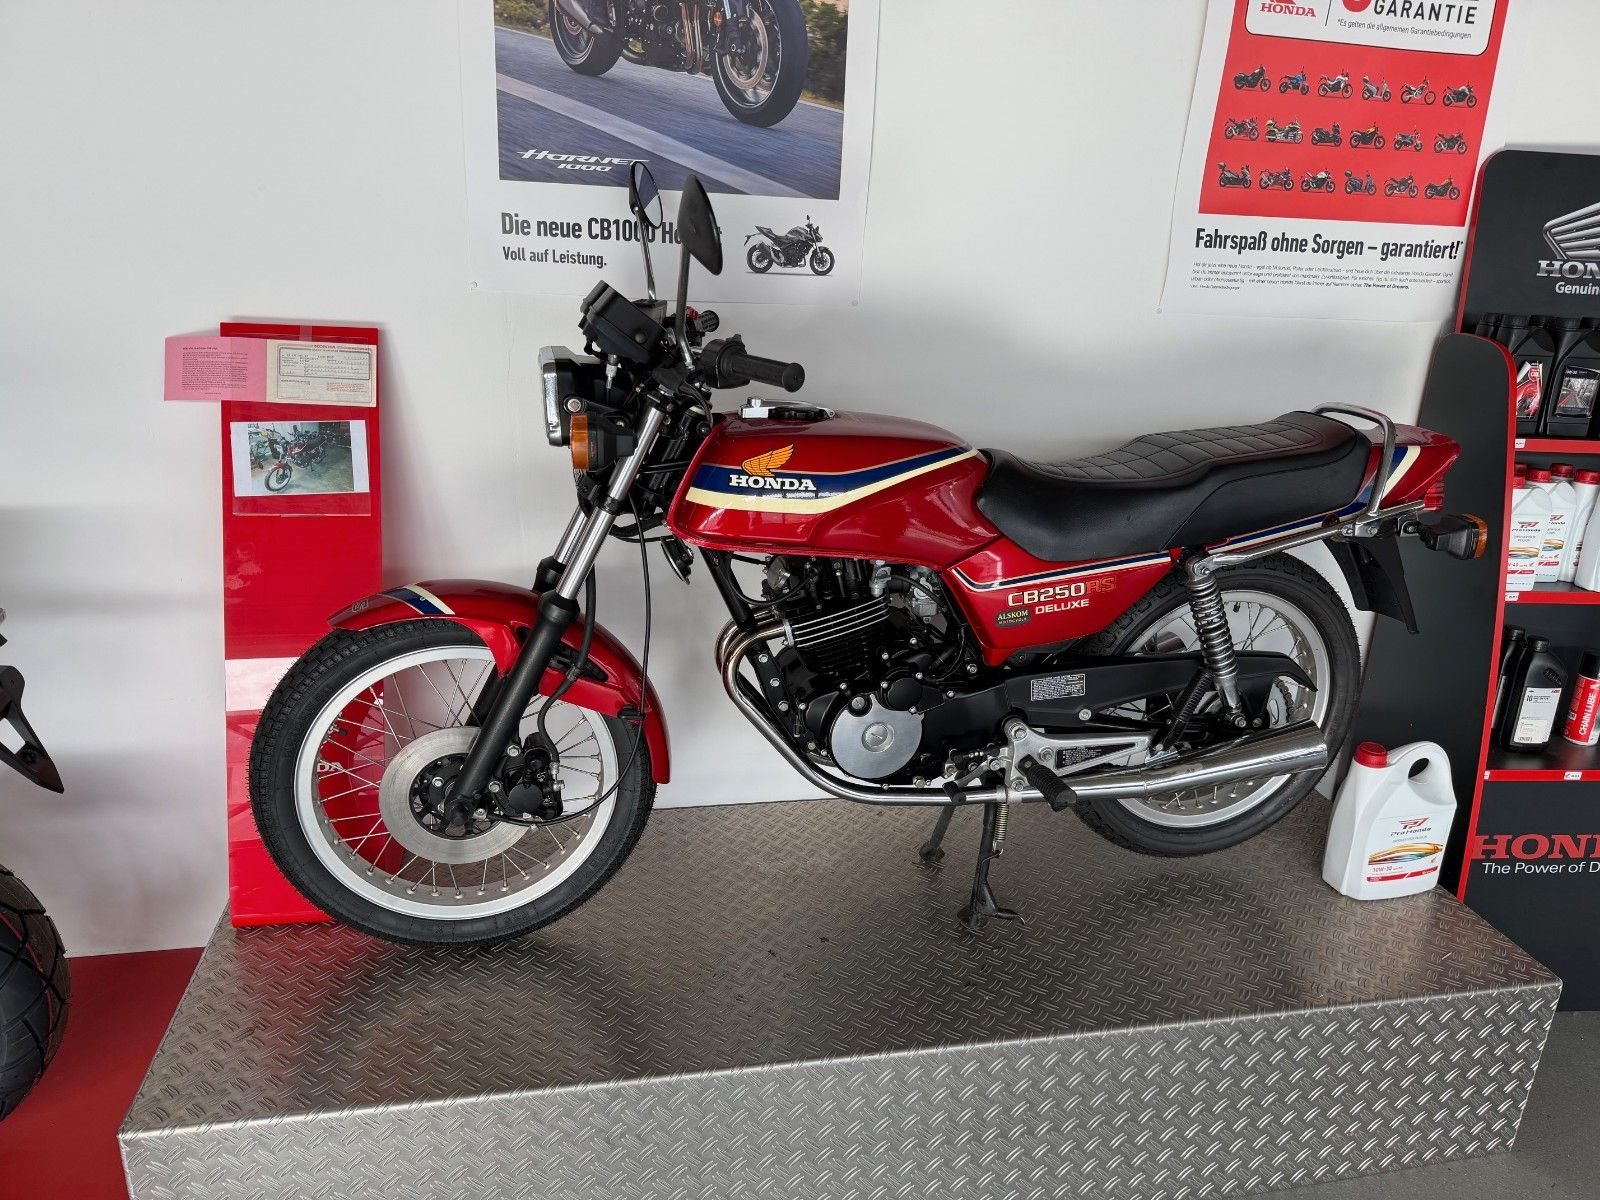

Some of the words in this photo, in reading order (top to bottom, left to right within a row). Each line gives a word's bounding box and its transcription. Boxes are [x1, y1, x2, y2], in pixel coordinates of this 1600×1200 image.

[1260, 3, 1316, 17] HONDA
[1374, 0, 1477, 24] GARANTIE
[1348, 20, 1366, 29] gelten
[1366, 22, 1376, 30] die
[1376, 23, 1409, 34] allgemeinen
[1410, 27, 1472, 39] Garantiebedingungen
[557, 163, 613, 172] 1000
[501, 212, 531, 236] Die
[537, 218, 582, 239] neue
[1195, 227, 1267, 255] Fahrspaß
[1271, 231, 1308, 253] ohne
[1311, 233, 1364, 259] Sorgen
[502, 246, 526, 262] Voll
[529, 249, 549, 263] auf
[552, 249, 607, 269] Leistung.
[1555, 281, 1600, 295] Genuin
[729, 474, 817, 491] HONDA
[1007, 576, 1116, 607] CB250RS
[997, 609, 1028, 620] ALSKOM
[1035, 599, 1090, 614] DELUXE
[1584, 692, 1597, 712] LUBE
[1578, 712, 1592, 735] CHAIN
[1470, 834, 1600, 860] HON
[1482, 862, 1511, 874] The
[1514, 862, 1565, 874] Power
[1568, 861, 1587, 873] of
